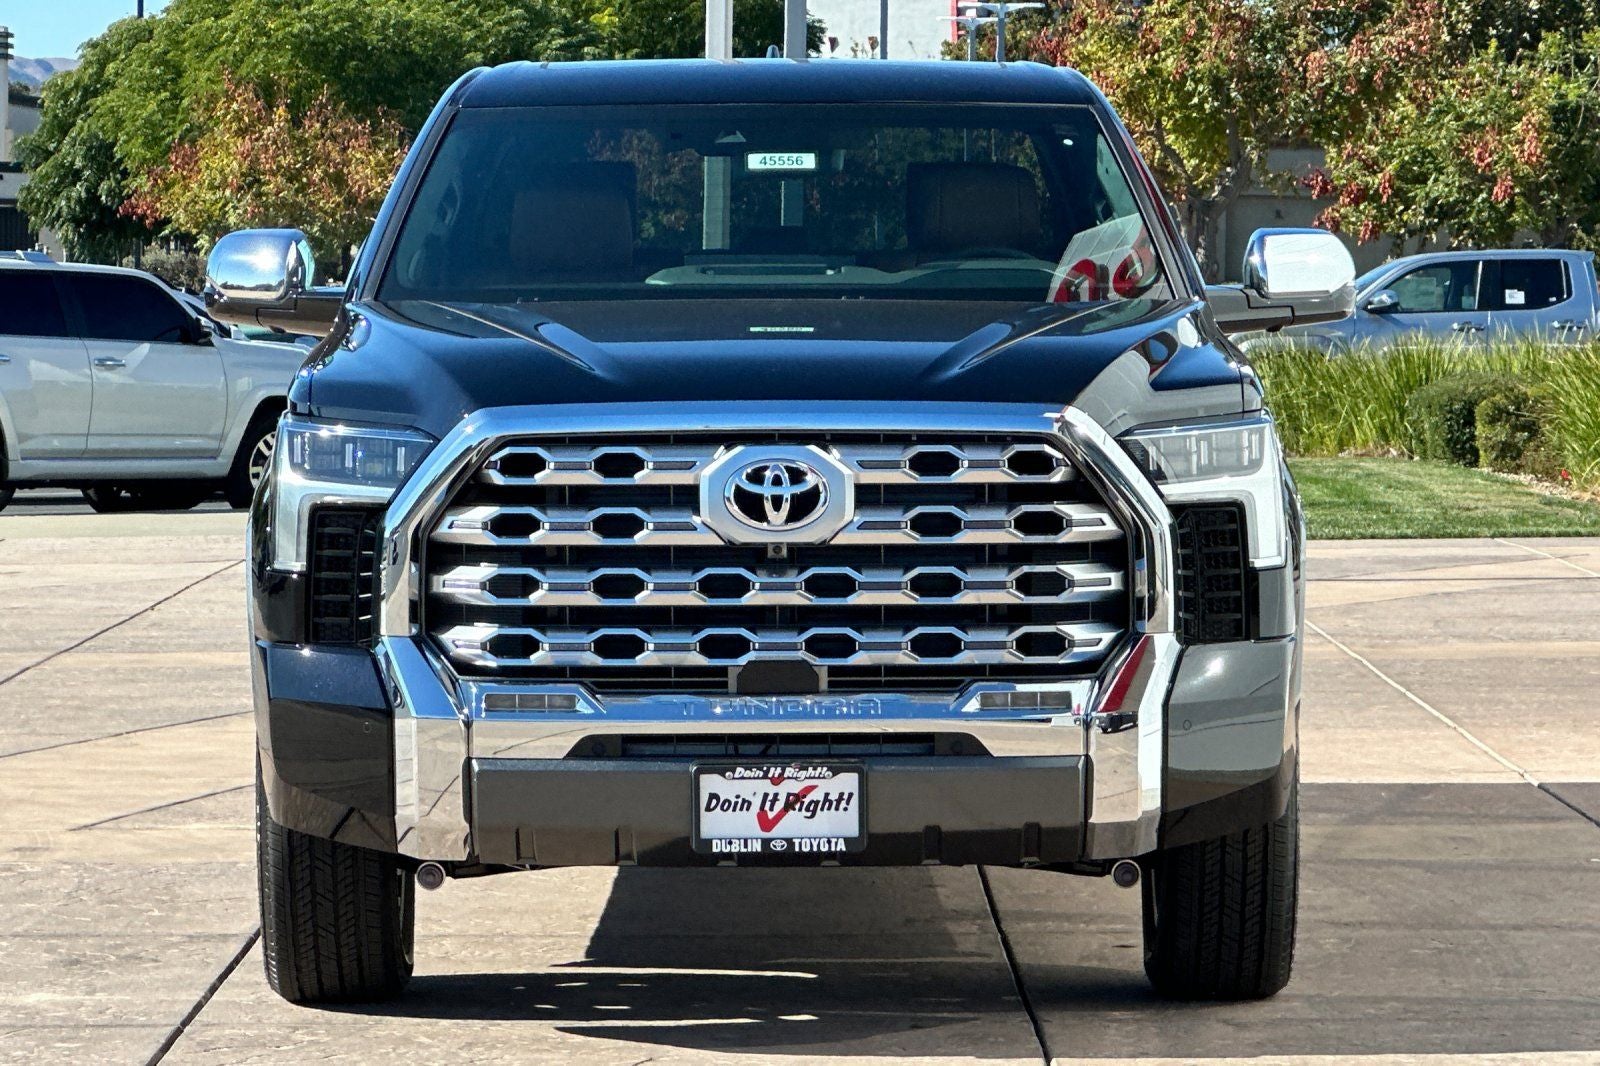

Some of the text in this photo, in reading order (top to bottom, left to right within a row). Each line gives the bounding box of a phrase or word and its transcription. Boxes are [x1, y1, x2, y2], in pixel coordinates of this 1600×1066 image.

[759, 155, 804, 166] 45556
[733, 767, 827, 781] Doin' It Right!
[704, 791, 855, 820] Doin' It Right!
[712, 838, 847, 853] DUBLIN TOYOTA
